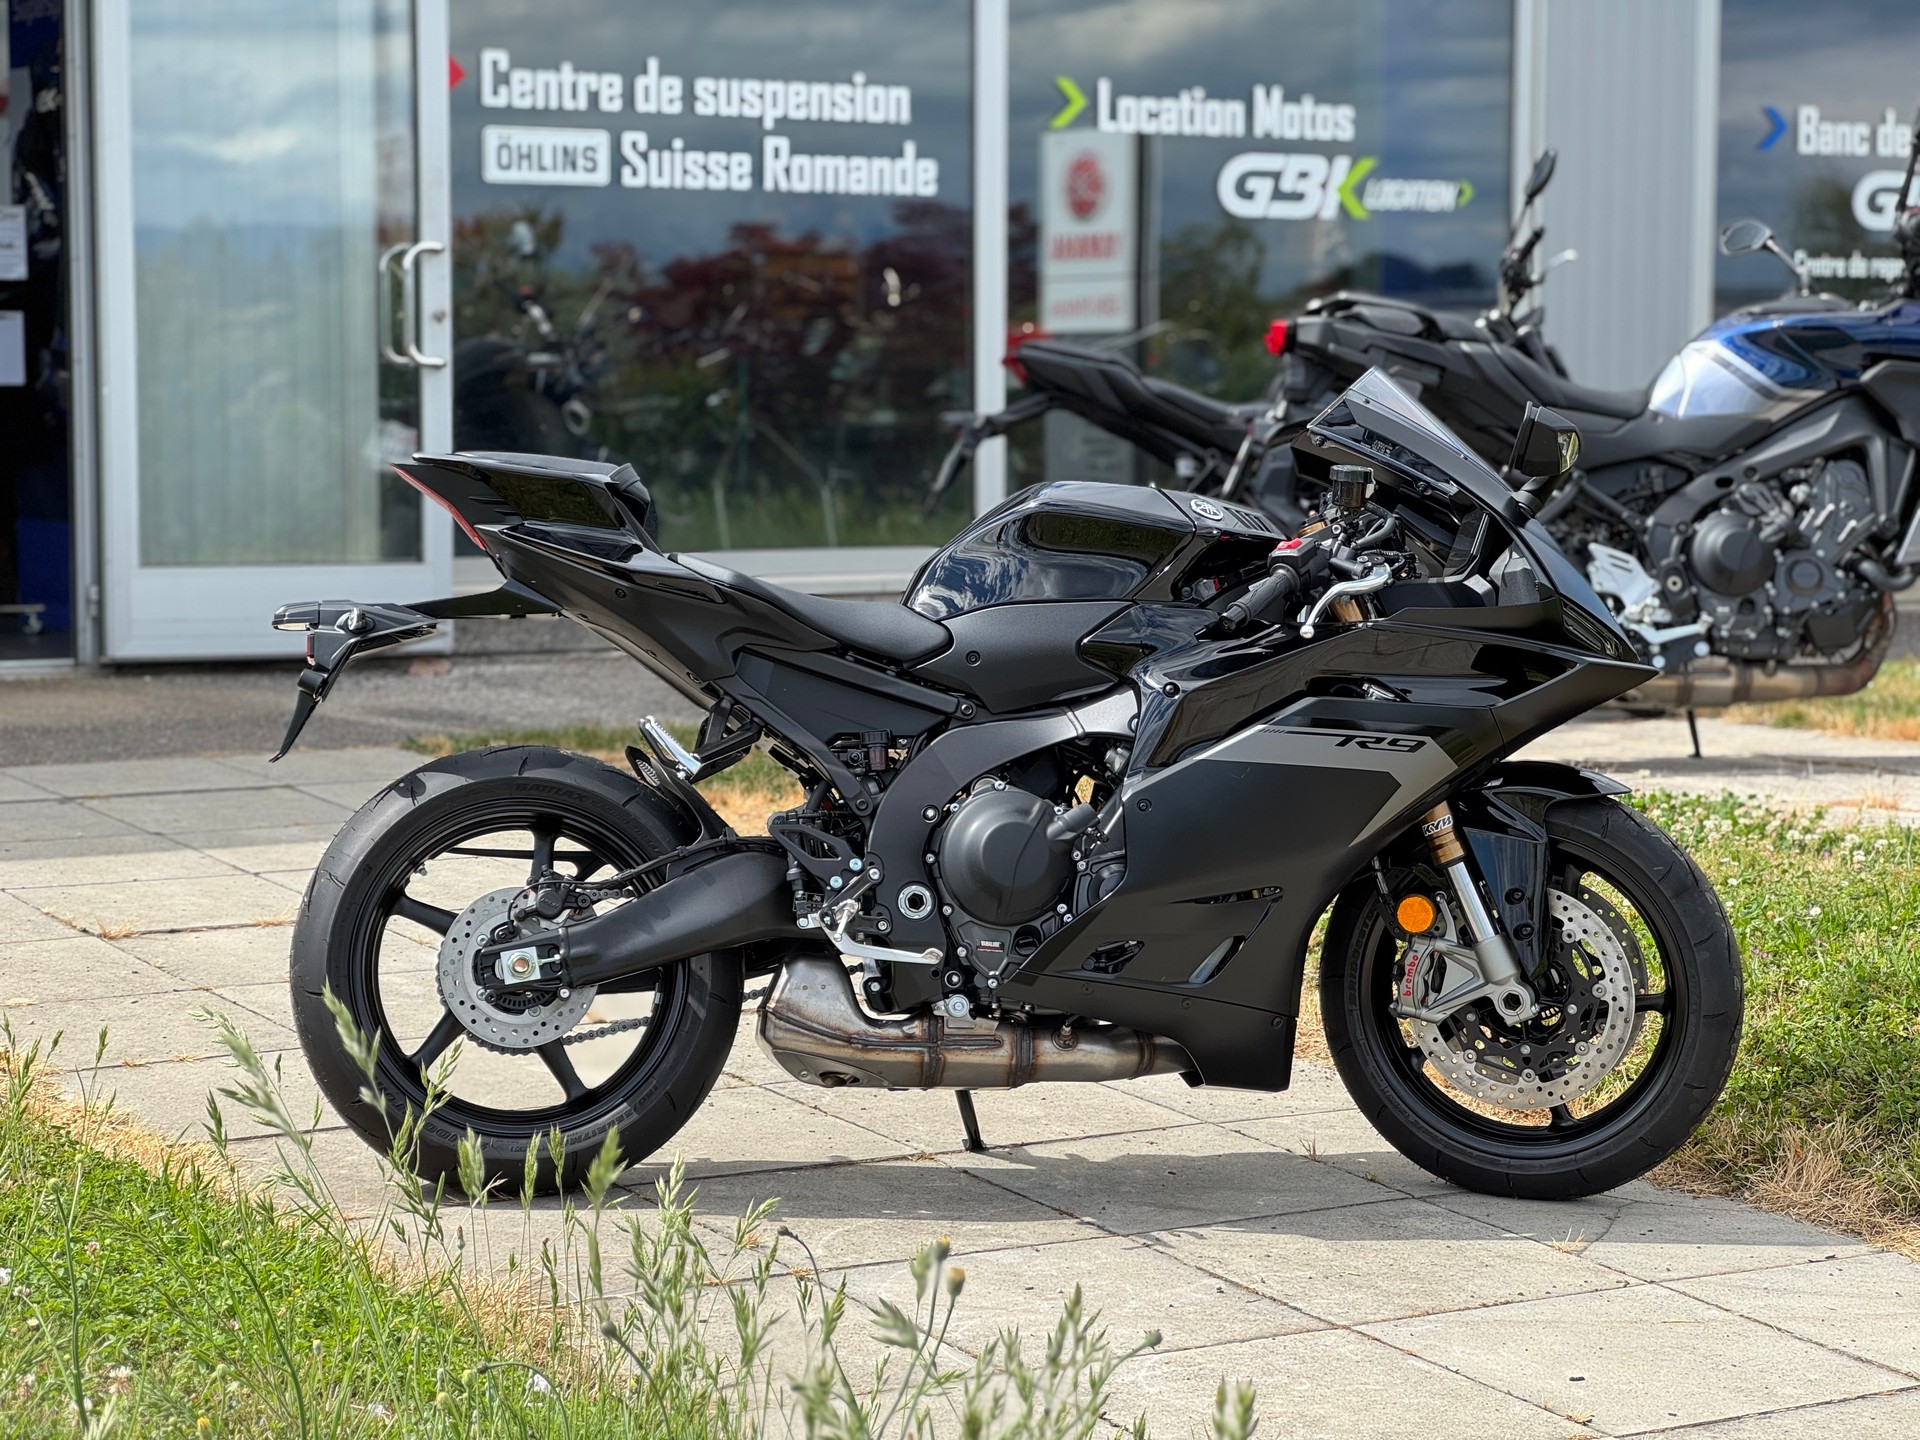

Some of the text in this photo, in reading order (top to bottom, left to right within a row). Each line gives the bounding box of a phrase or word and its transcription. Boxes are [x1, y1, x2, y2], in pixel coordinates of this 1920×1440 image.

[480, 47, 911, 130] Centre de suspension
[1097, 76, 1356, 142] Location Motos
[497, 136, 598, 173] ÖHLINS
[1797, 104, 1911, 157] Banc de
[620, 131, 939, 196] Suisse Romande
[1216, 151, 1378, 220] GBK
[1335, 736, 1428, 754] R9
[1422, 815, 1452, 836] KYB
[1403, 954, 1419, 998] brembo
